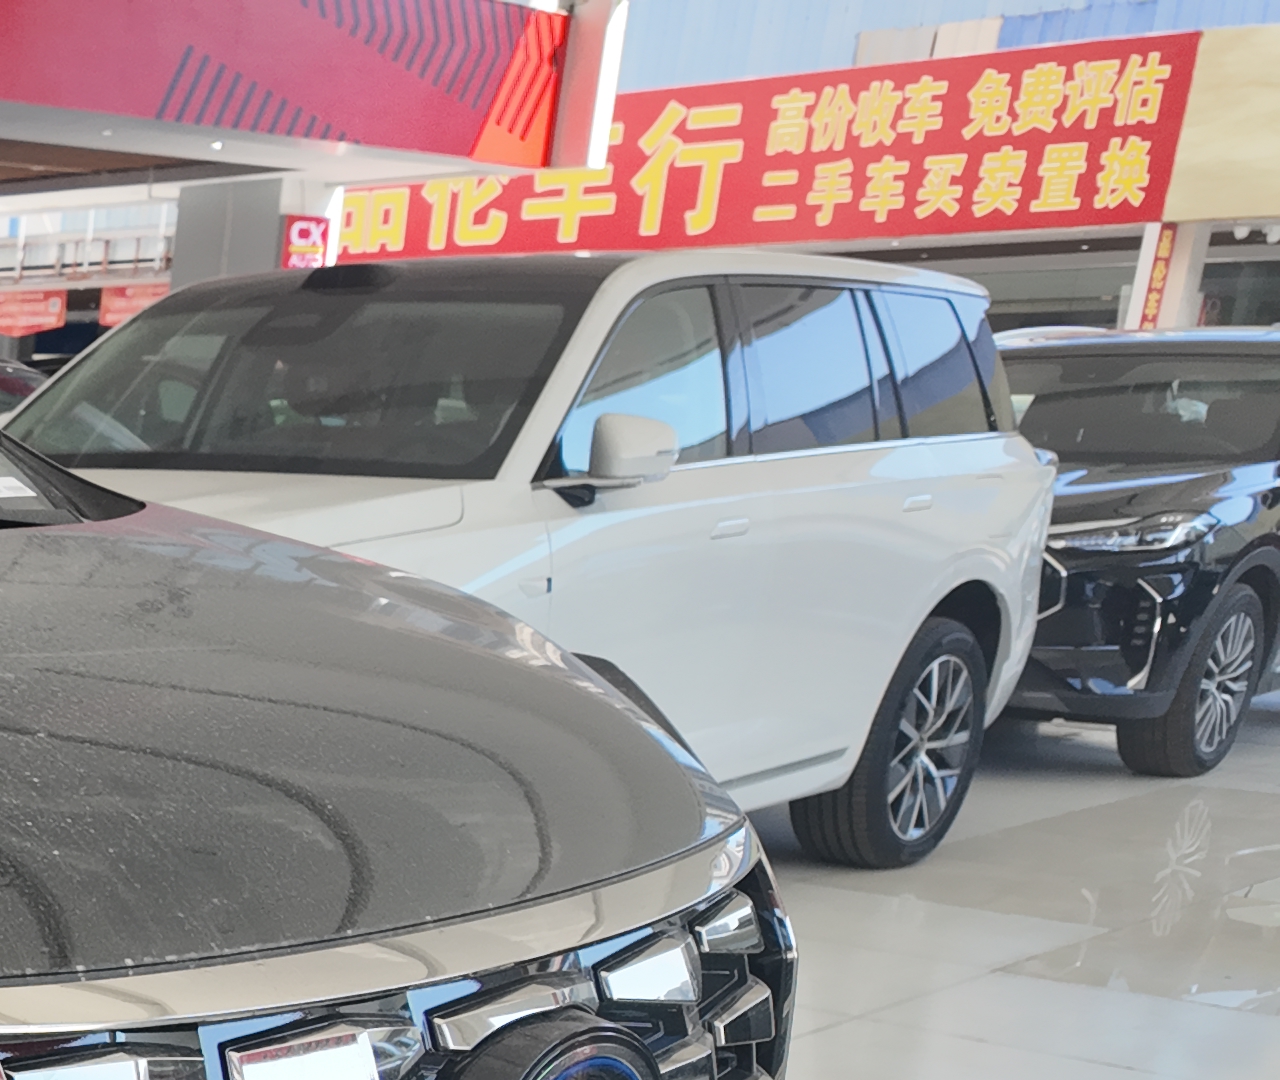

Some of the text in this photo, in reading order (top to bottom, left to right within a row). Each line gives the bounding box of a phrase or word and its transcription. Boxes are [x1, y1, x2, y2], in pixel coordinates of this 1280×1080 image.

[765, 51, 1172, 157] 高价收车 免费评估
[752, 136, 1152, 228] 二手车买卖置换
[289, 219, 327, 247] CX
